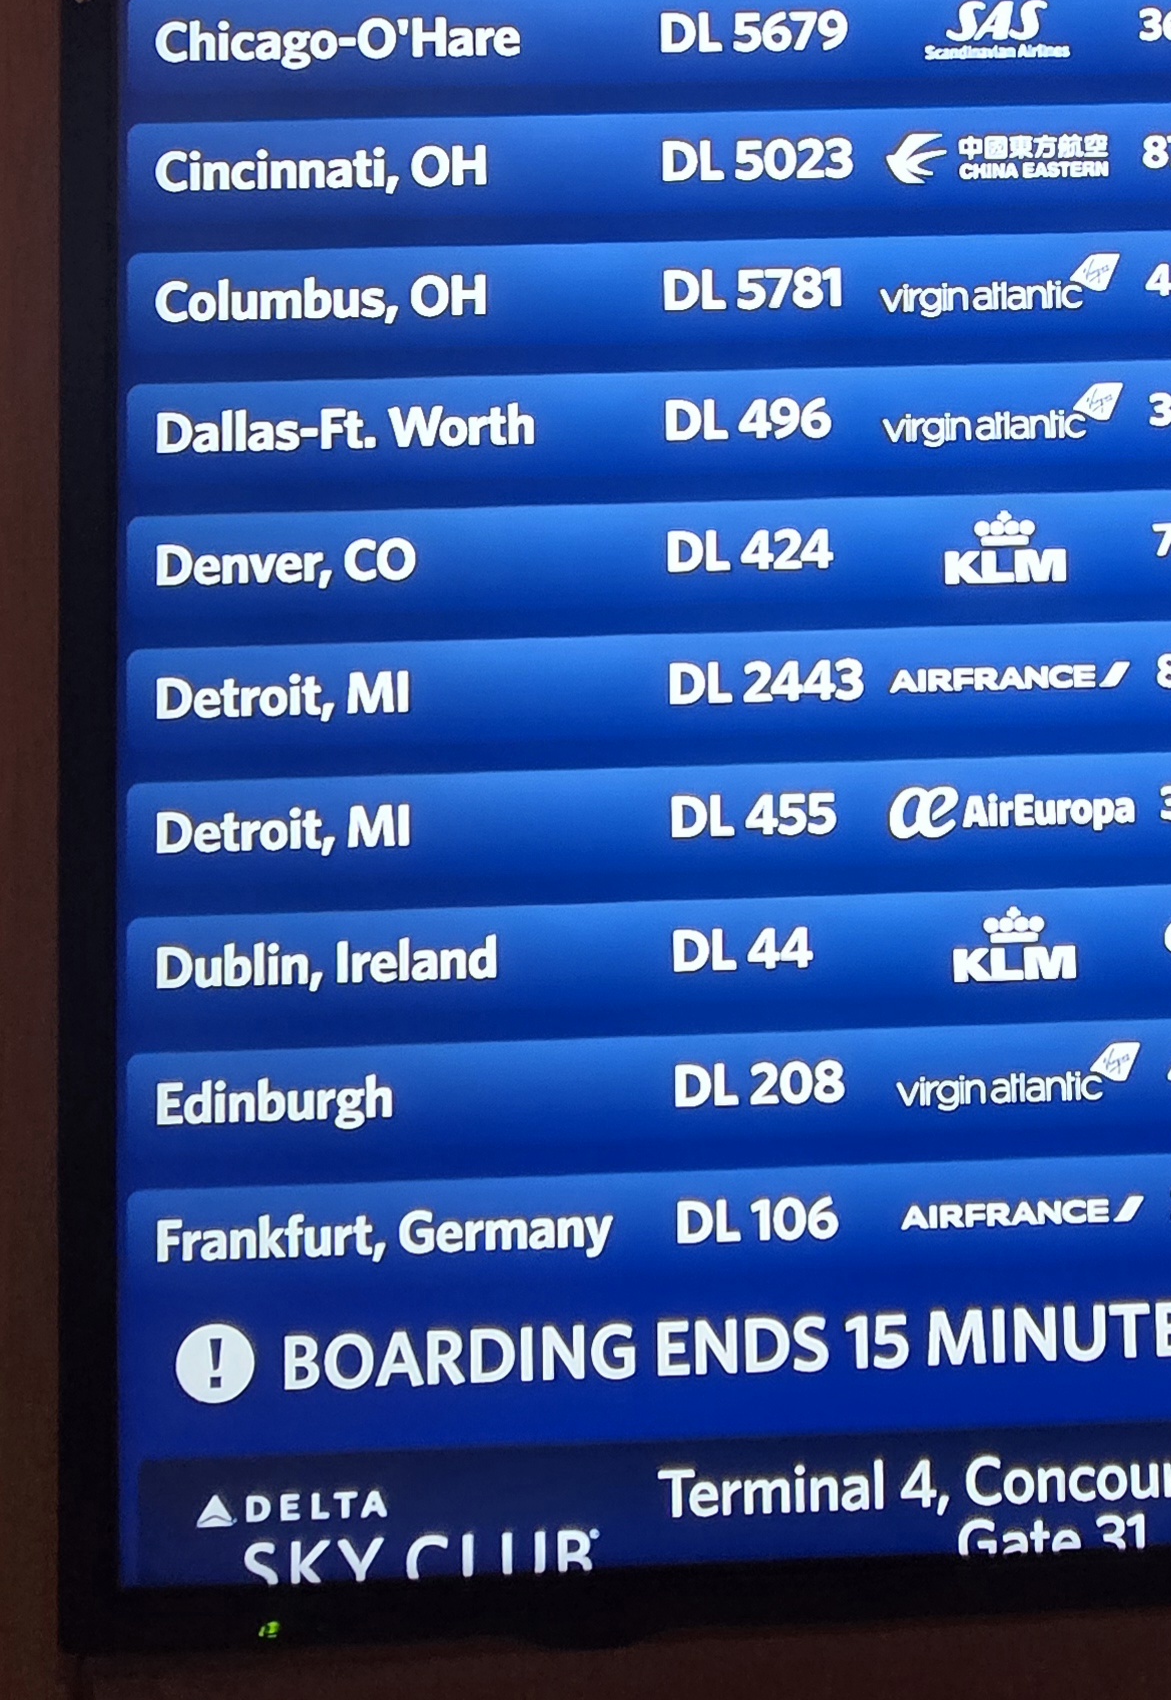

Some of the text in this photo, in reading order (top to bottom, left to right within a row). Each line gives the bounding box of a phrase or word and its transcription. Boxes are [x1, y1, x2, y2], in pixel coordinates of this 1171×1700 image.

[155, 16, 521, 71] Chicago-O'Hare
[924, 43, 1071, 61] Scandinavian Airlines
[155, 144, 488, 195] Cincinnati, OH
[957, 133, 1110, 161] 中國東方航空
[957, 160, 1110, 181] CHINA EASTERN
[155, 273, 487, 325] Columbus, OH
[879, 280, 1084, 319] virgin atlantic
[156, 402, 535, 454] Dallas-Ft. Worth
[882, 409, 1087, 449] virgin atlantic
[156, 537, 417, 589] Denver, CO
[667, 527, 834, 573] DL 424
[944, 548, 1067, 585] KLM
[156, 670, 410, 723] Detroit, MI
[156, 933, 497, 992] Dublin, Ireland
[952, 944, 1077, 983] KLM
[156, 1073, 393, 1130] Edinburgh
[895, 1067, 1104, 1114] virgin atlantic
[156, 1209, 614, 1263] Frankfurt, Germany
[676, 1195, 839, 1244] DL 106
[284, 1322, 636, 1391] BOARDING
[656, 1315, 829, 1377] ENDS
[844, 1313, 910, 1370] 15
[245, 1490, 388, 1523] DELTA
[657, 1458, 884, 1518] Terminal
[900, 1458, 950, 1516] 4,
